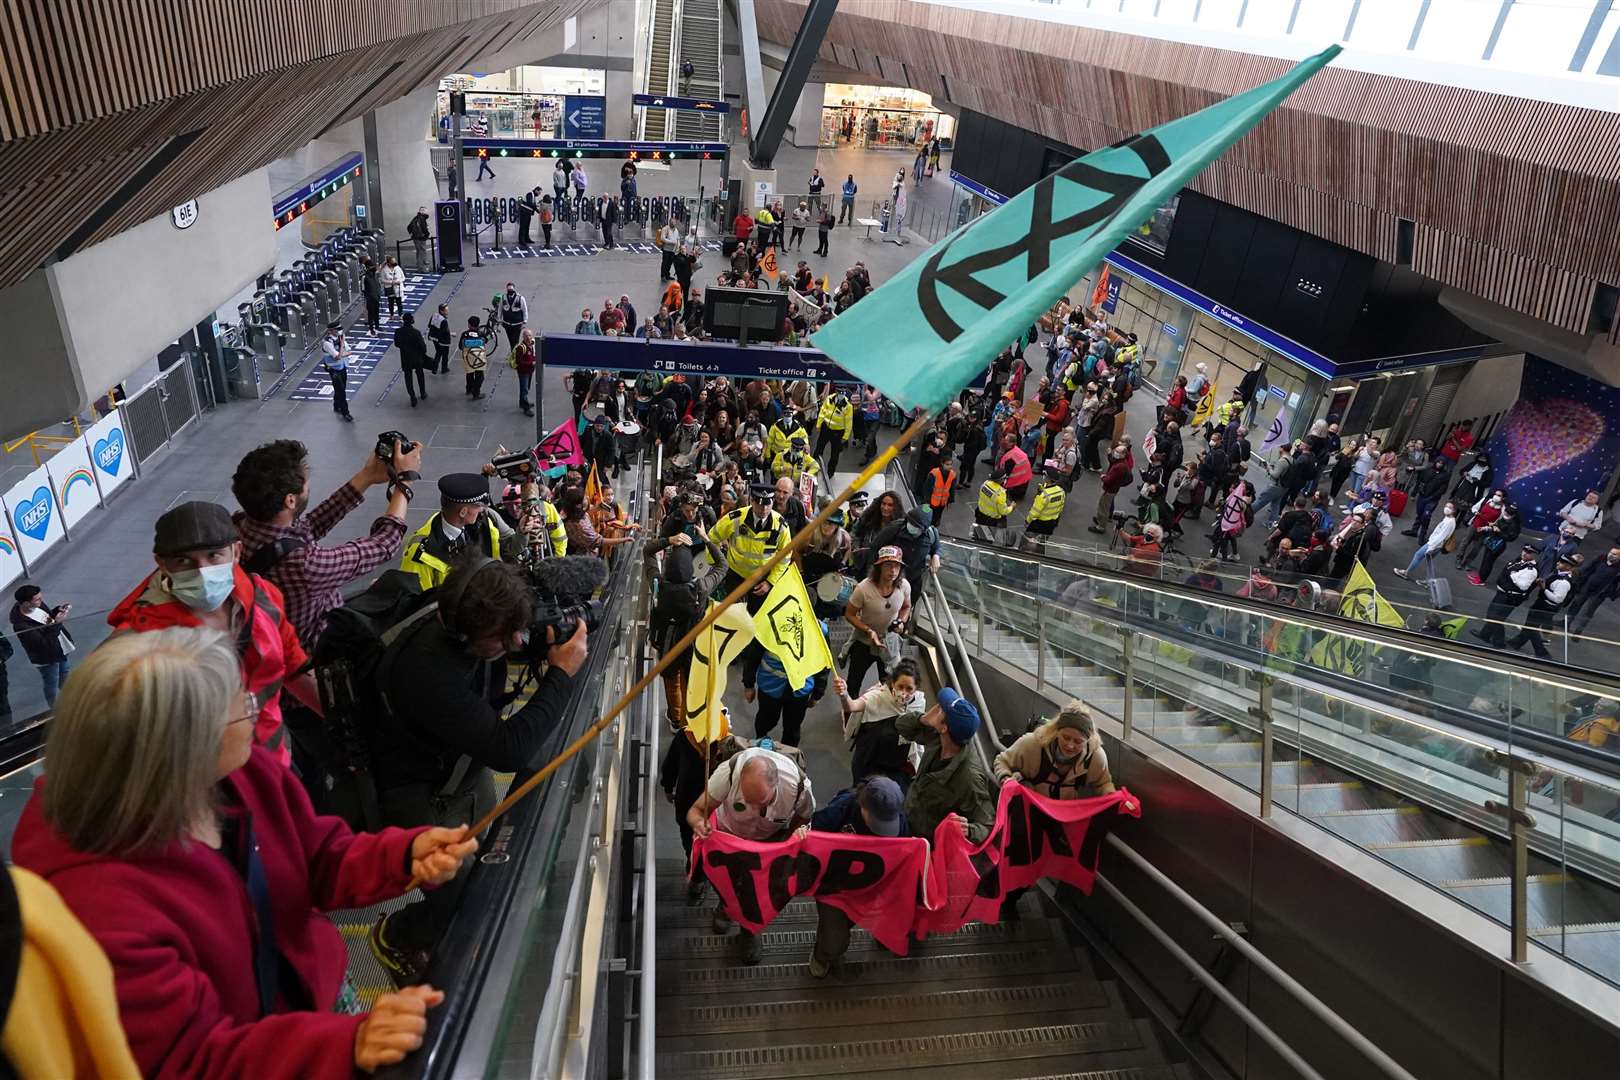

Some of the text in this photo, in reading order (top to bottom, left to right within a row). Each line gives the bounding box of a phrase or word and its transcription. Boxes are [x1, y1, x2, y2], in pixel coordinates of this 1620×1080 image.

[1220, 308, 1244, 325] Ticket office
[678, 361, 704, 371] Toilets
[758, 367, 781, 375] Ticket
[100, 441, 120, 465] NHS
[23, 501, 48, 528] NHS
